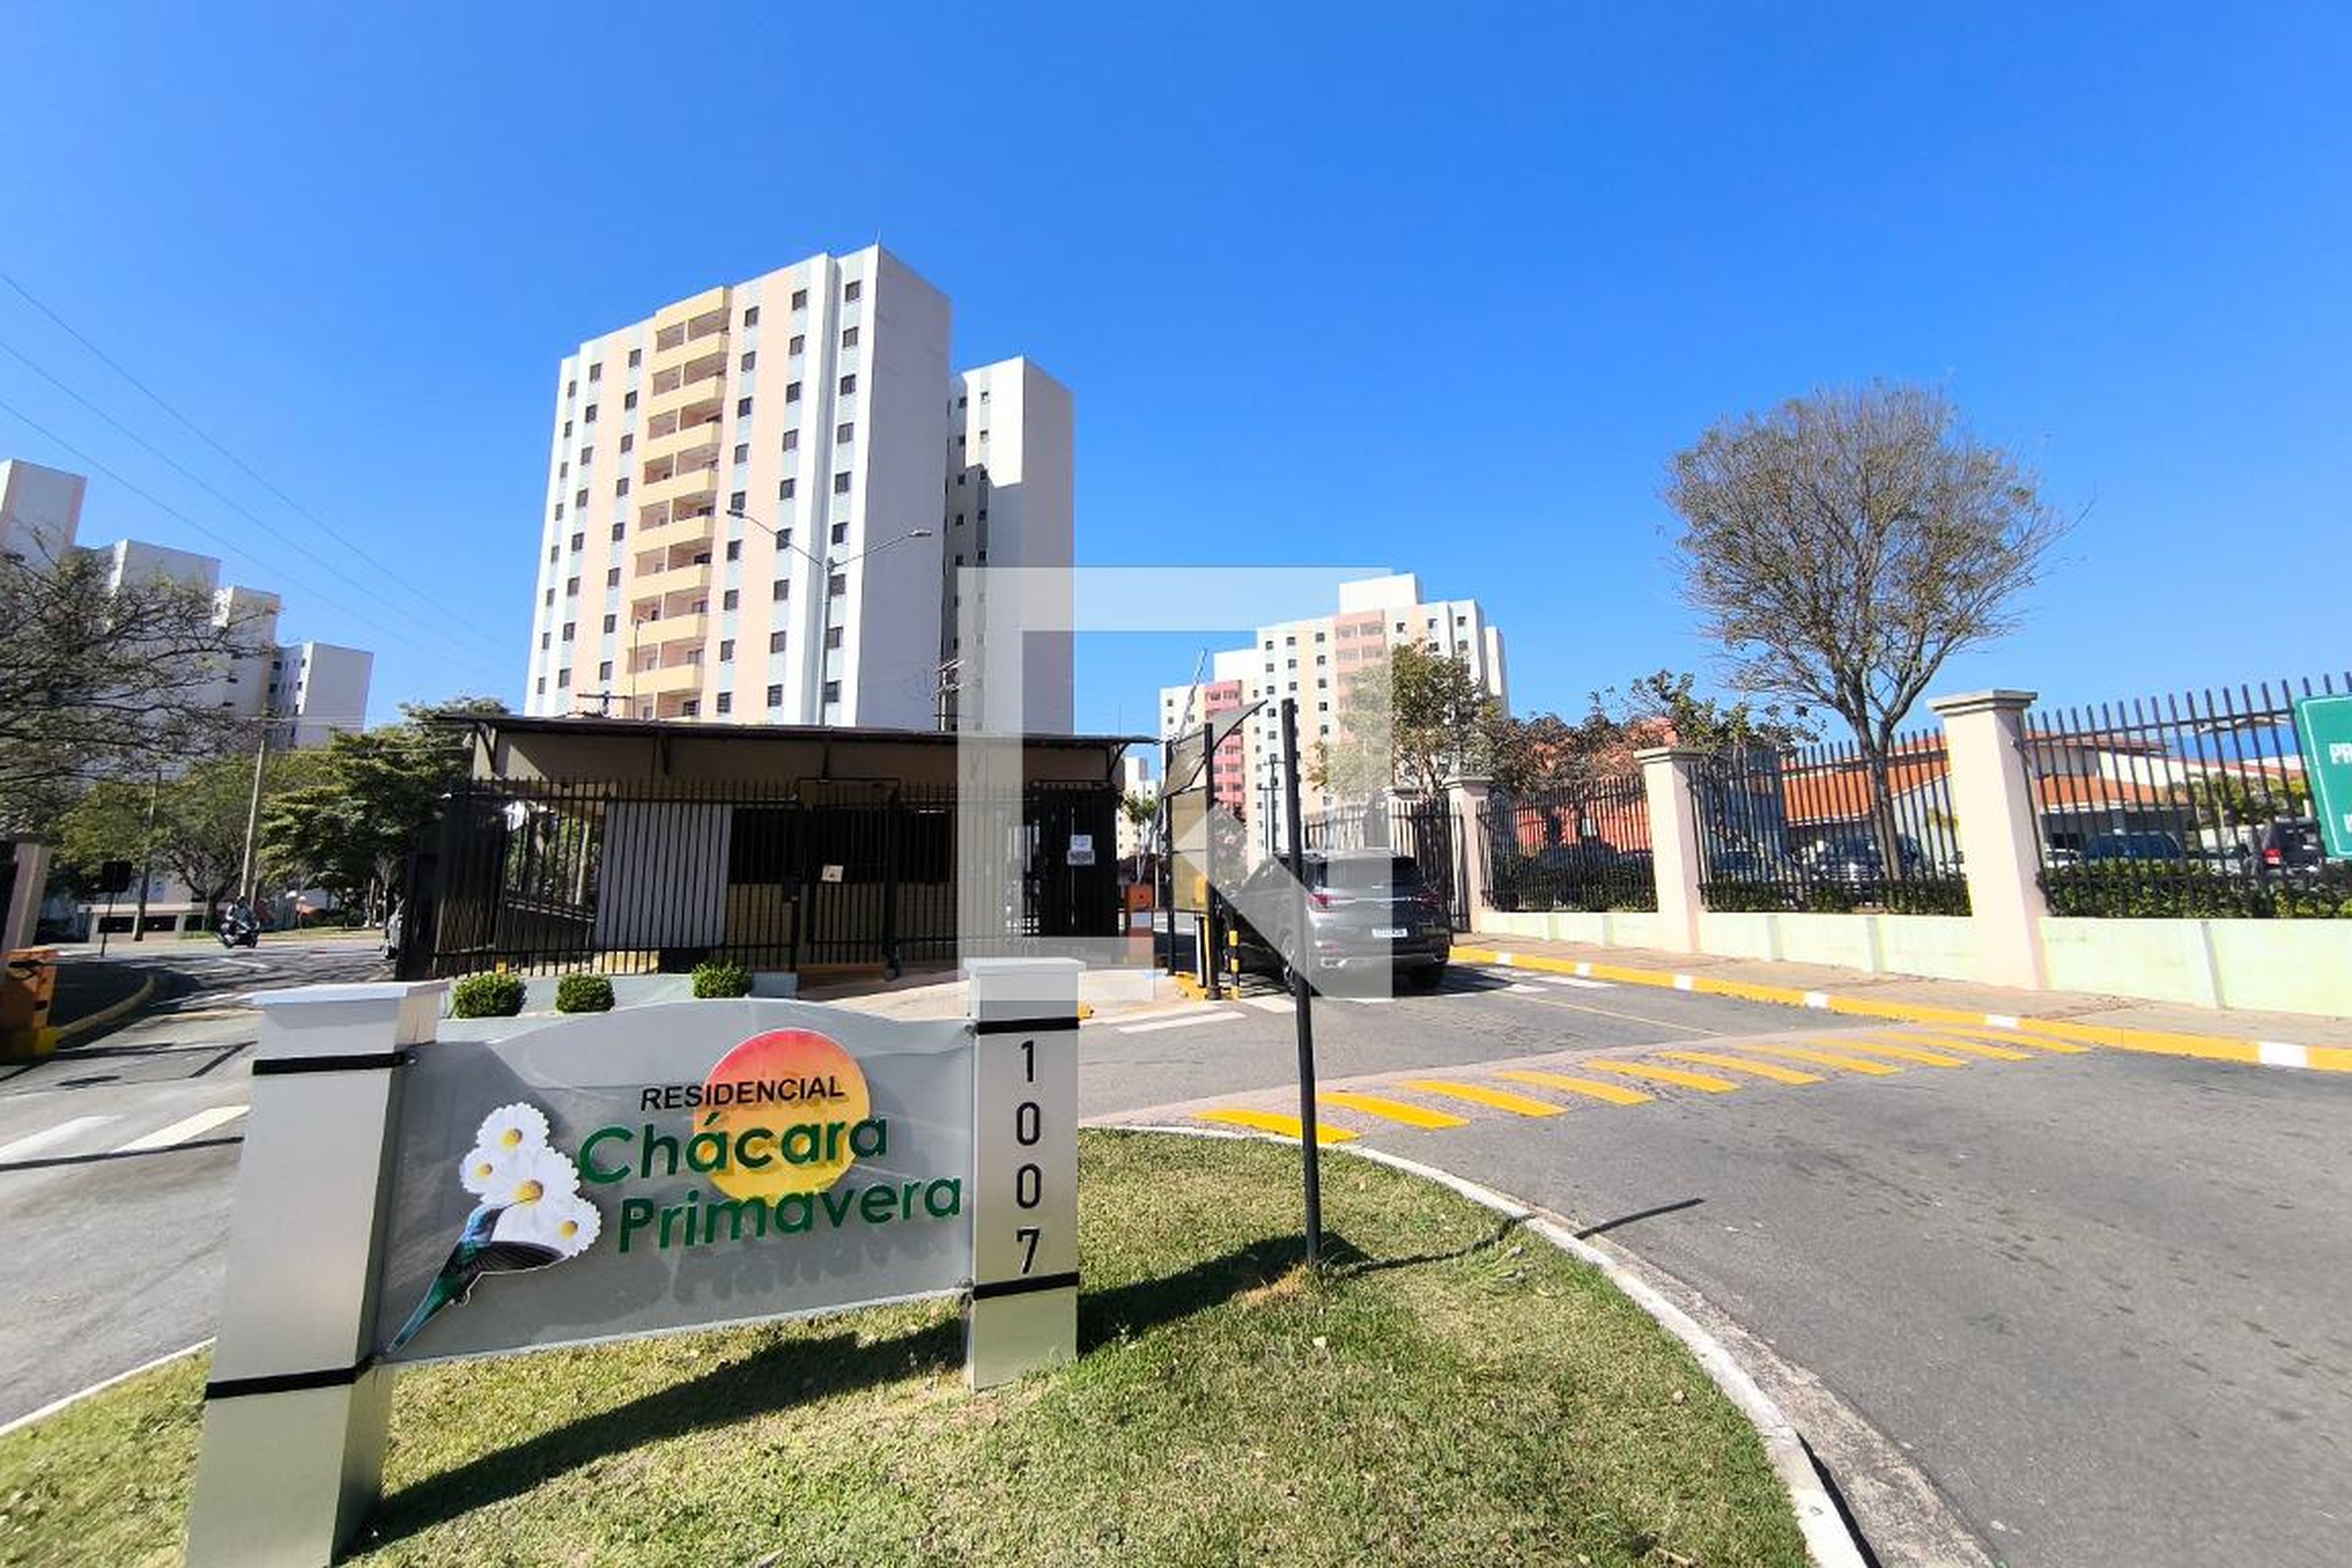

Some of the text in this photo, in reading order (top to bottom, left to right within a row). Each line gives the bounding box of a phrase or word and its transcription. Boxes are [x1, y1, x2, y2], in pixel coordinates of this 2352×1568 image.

[641, 1076, 845, 1111] RESIDENCIAL
[579, 1112, 887, 1185] Chácara
[1016, 1039, 1041, 1274] 1007
[620, 1177, 962, 1253] Primavera
